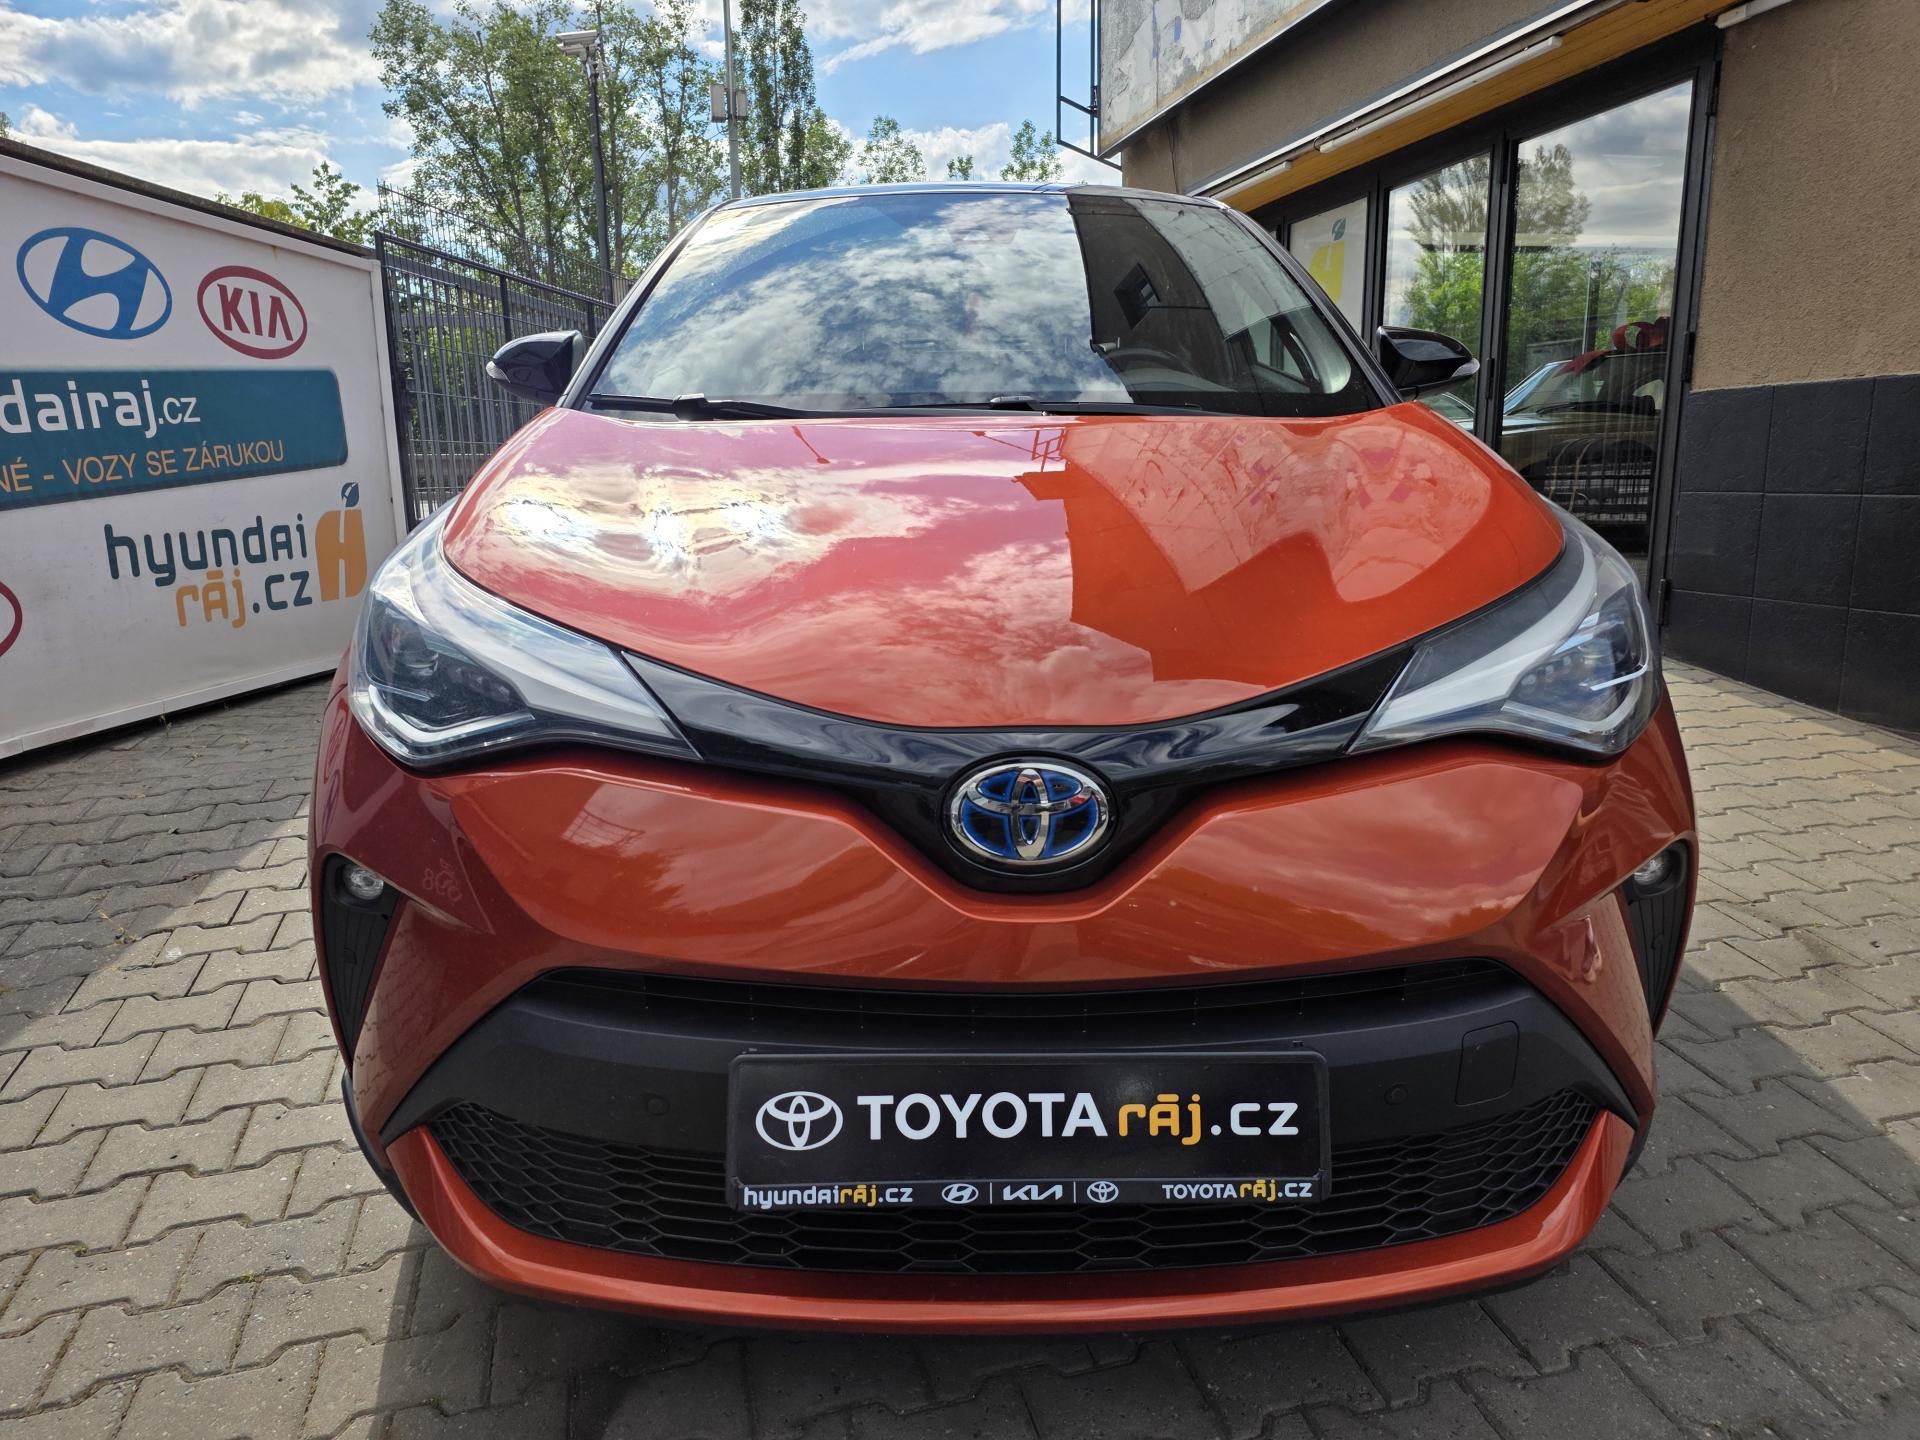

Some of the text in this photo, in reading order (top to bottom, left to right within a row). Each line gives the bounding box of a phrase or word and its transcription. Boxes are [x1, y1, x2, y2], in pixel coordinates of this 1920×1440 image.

[216, 283, 294, 342] KIA
[0, 379, 201, 439] dairaj.cz
[62, 453, 137, 486] VOZY
[146, 451, 181, 475] SE
[183, 440, 284, 472] ZÁRUKOU
